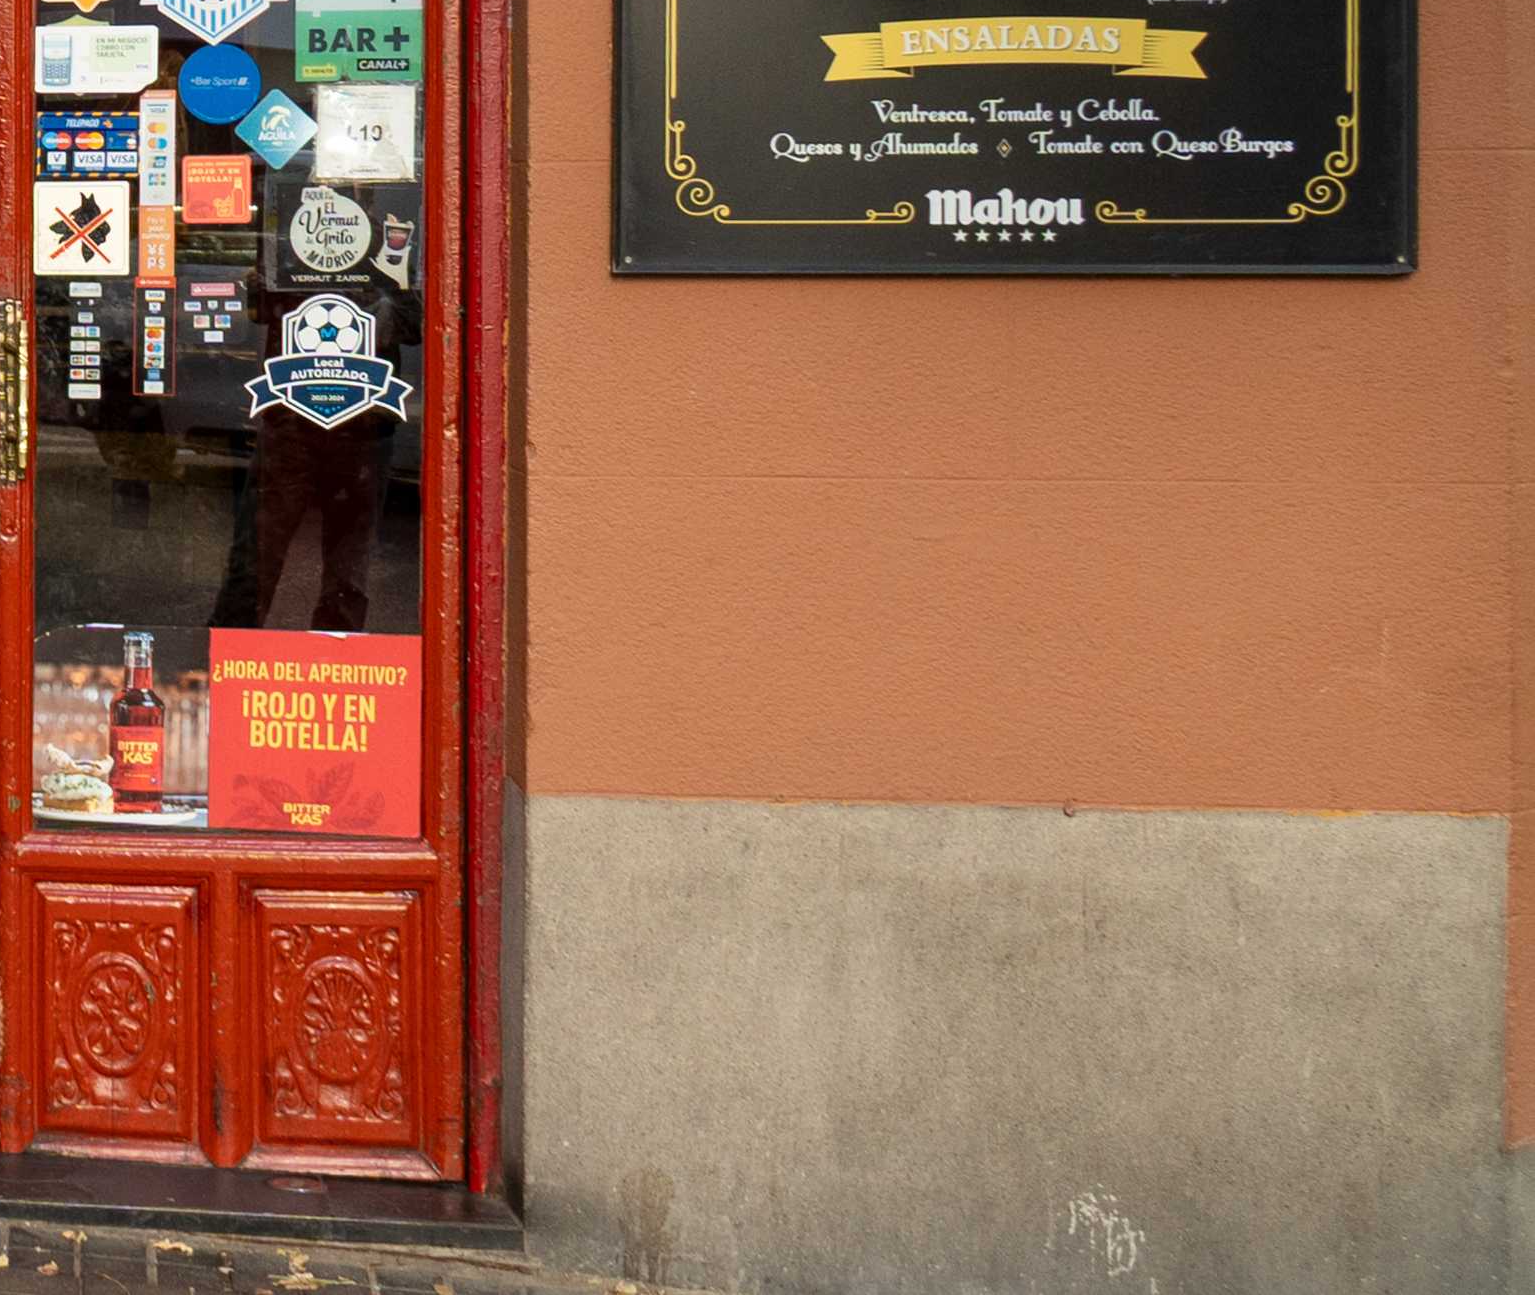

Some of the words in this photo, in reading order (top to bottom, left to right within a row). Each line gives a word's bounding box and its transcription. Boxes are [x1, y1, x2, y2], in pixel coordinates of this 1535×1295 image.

[904, 26, 1119, 53] ENSALADAS
[358, 58, 409, 71] CANAL+
[871, 100, 975, 123] Ventresca,
[979, 98, 1052, 122] Tomate
[1059, 103, 1073, 128] y
[1078, 99, 1159, 121] Cebolla.
[77, 153, 104, 164] VISA
[110, 153, 136, 164] VISA
[324, 202, 337, 215] EL
[925, 188, 1085, 225] Mahou
[298, 206, 361, 235] Vermut
[315, 227, 356, 249] Grifo
[305, 250, 357, 269] MADRID
[290, 274, 332, 283] VERMUT
[335, 274, 371, 283] ZARRO
[313, 357, 345, 368] Local
[212, 659, 269, 683] ¿HORA
[273, 661, 304, 683] DEL
[308, 664, 408, 686] APERITIVO?
[242, 690, 316, 721] ¡ROJO
[322, 693, 340, 721] Y
[344, 694, 376, 723] EN
[249, 721, 368, 753] BOTELLA!
[117, 740, 159, 753] BITTER
[122, 751, 154, 765] KAS
[283, 802, 331, 815] BITTER
[290, 813, 323, 826] KAS
